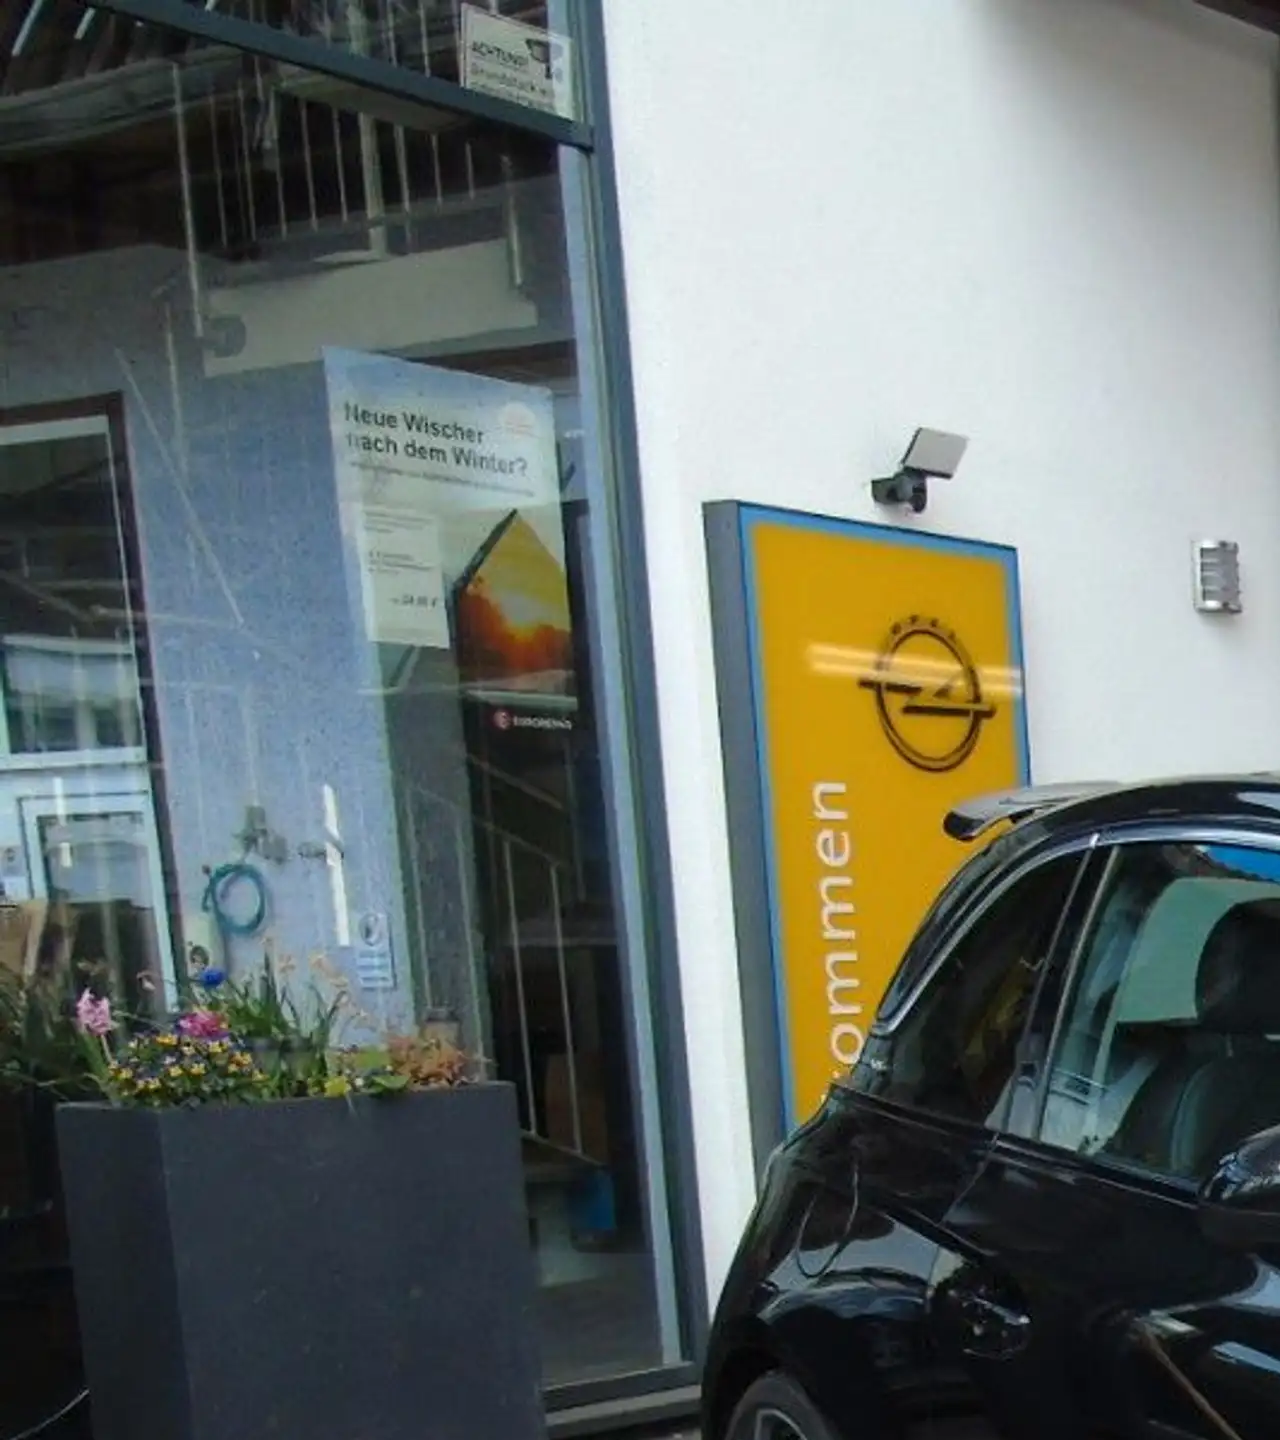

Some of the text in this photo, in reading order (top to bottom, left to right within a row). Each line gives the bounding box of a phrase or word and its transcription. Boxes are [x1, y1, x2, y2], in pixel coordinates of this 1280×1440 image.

[344, 401, 398, 428] Neue
[402, 411, 484, 444] Wischer
[346, 432, 528, 476] nach dem Winter?
[812, 780, 866, 1078] ommen
